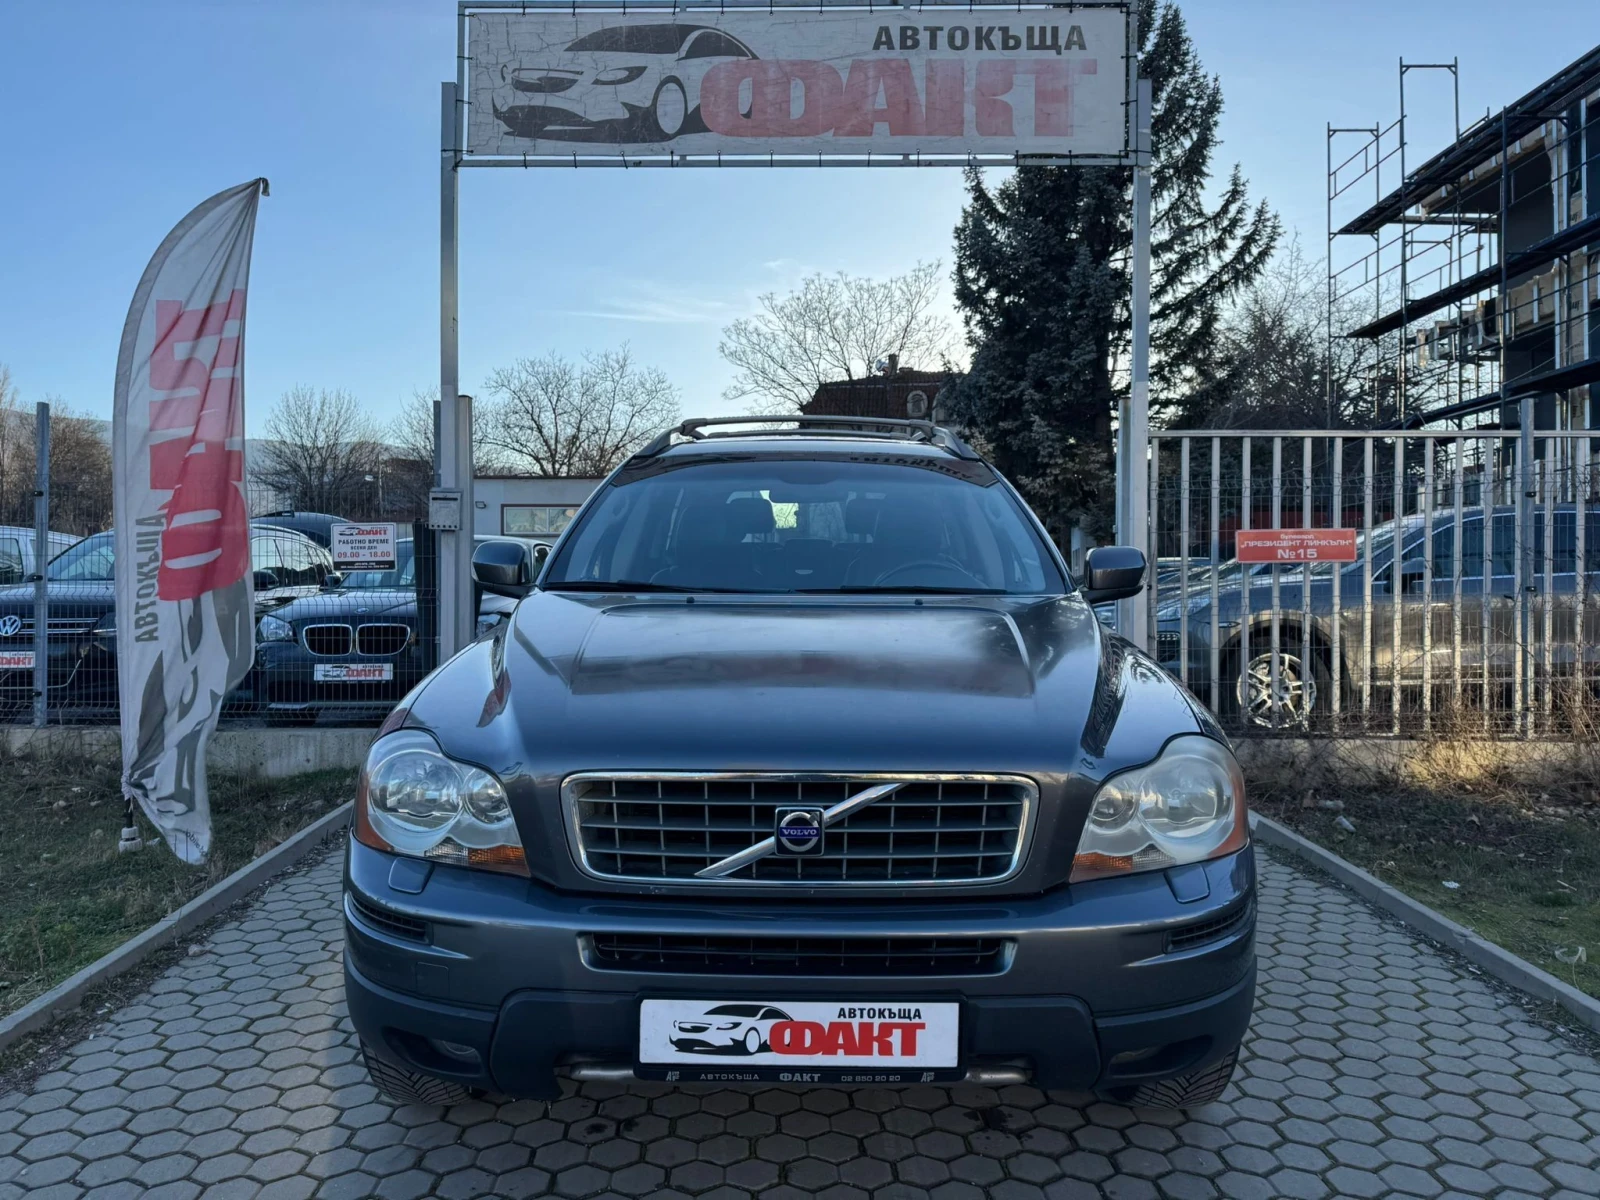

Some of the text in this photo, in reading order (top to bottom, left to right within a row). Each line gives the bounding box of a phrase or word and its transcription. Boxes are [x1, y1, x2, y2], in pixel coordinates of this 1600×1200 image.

[873, 25, 1087, 55] АВТОКЪЩА
[700, 58, 1097, 138] ФАКТ
[782, 828, 817, 836] VOLVO
[838, 1007, 922, 1020] АВТОКЪЩА
[769, 1020, 926, 1057] ФАКТ
[779, 1072, 821, 1083] ФАКТ
